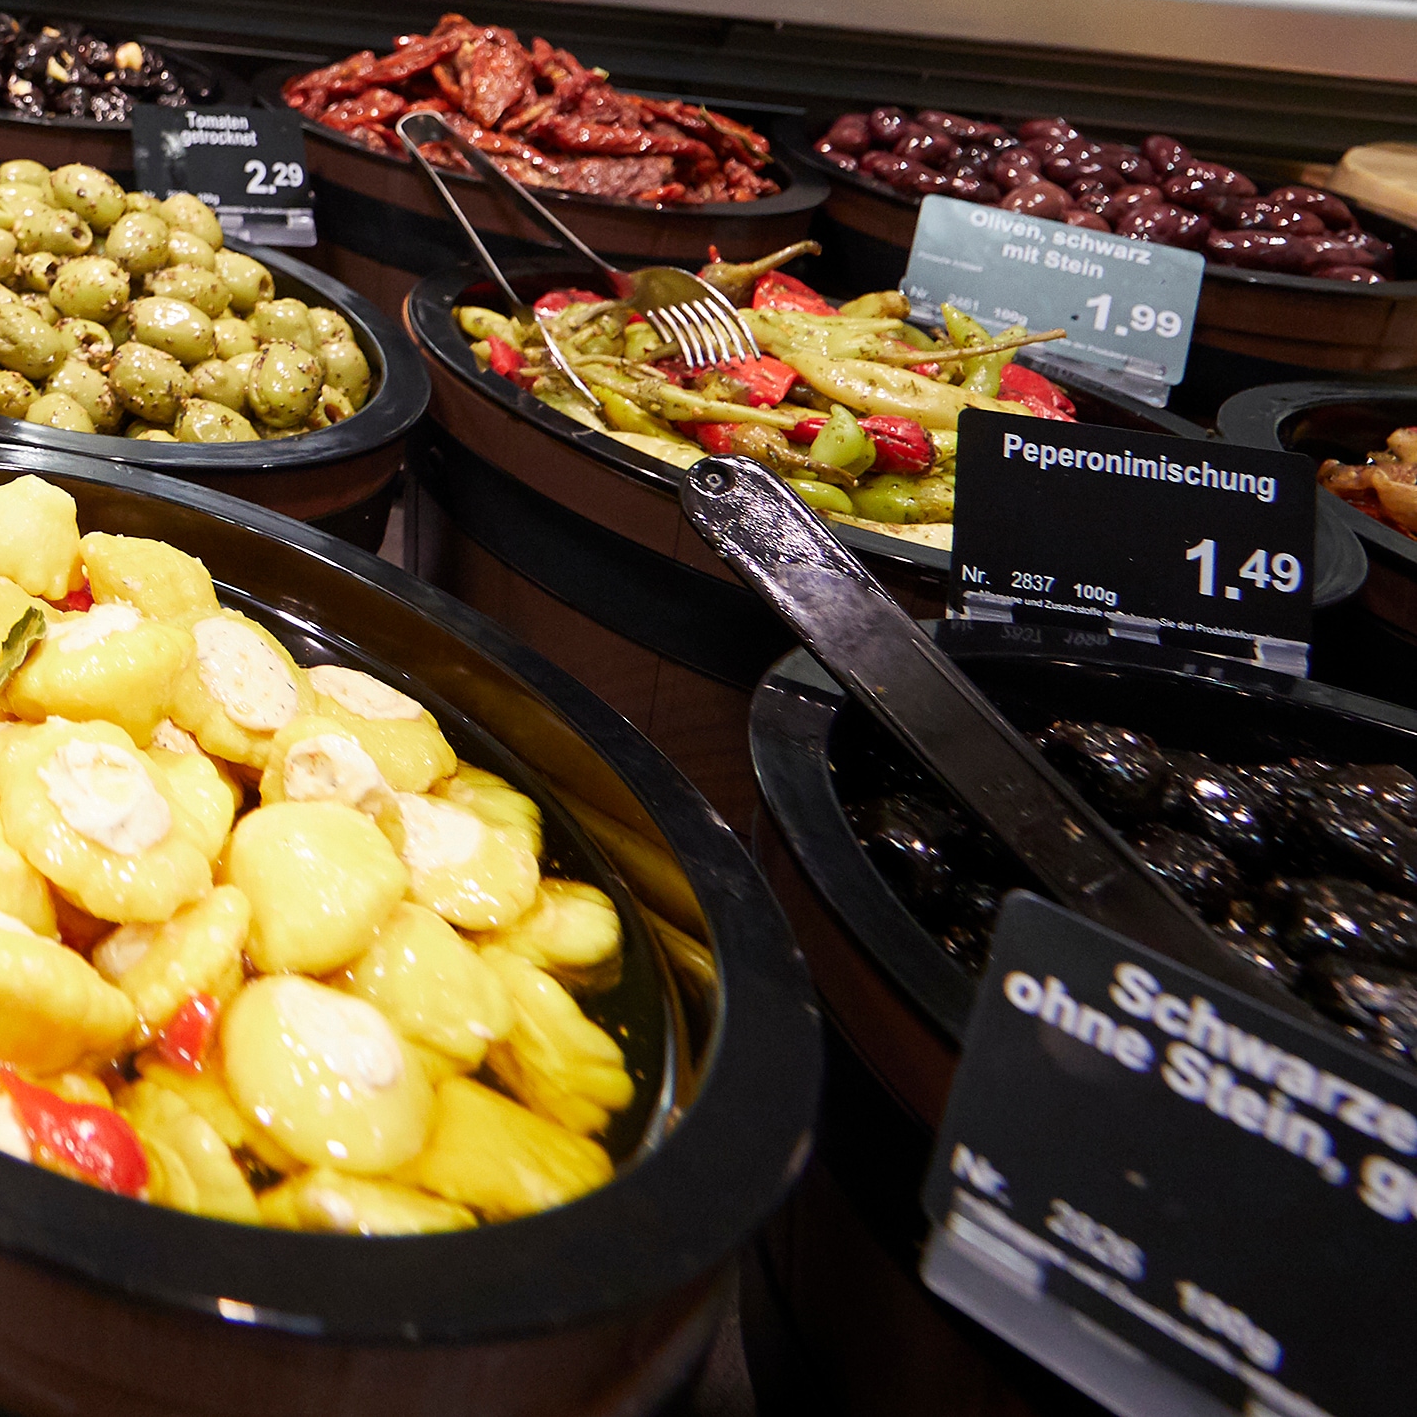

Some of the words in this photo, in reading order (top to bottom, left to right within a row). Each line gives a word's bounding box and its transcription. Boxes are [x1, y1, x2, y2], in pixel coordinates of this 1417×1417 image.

[180, 129, 258, 147] getrocknet
[185, 111, 249, 131] Tomaten
[243, 159, 304, 195] 2.29
[968, 208, 1047, 245] Oliven,
[1052, 230, 1152, 266] schwarz
[1001, 242, 1040, 265] mit
[1043, 250, 1104, 280] Stein
[1086, 293, 1182, 338] 1.99
[1002, 432, 1277, 503] Peperonimischung
[961, 564, 991, 586] Nr.
[1011, 570, 1055, 593] 2837
[1072, 582, 1118, 607] 100g
[1185, 538, 1303, 601] 1.49
[1023, 596, 1043, 609] und
[1043, 598, 1104, 619] Zusatzstoffe
[1158, 616, 1176, 629] Sie
[1176, 618, 1194, 632] der
[1003, 970, 1155, 1072] ohne
[1160, 1040, 1349, 1186] Stein,
